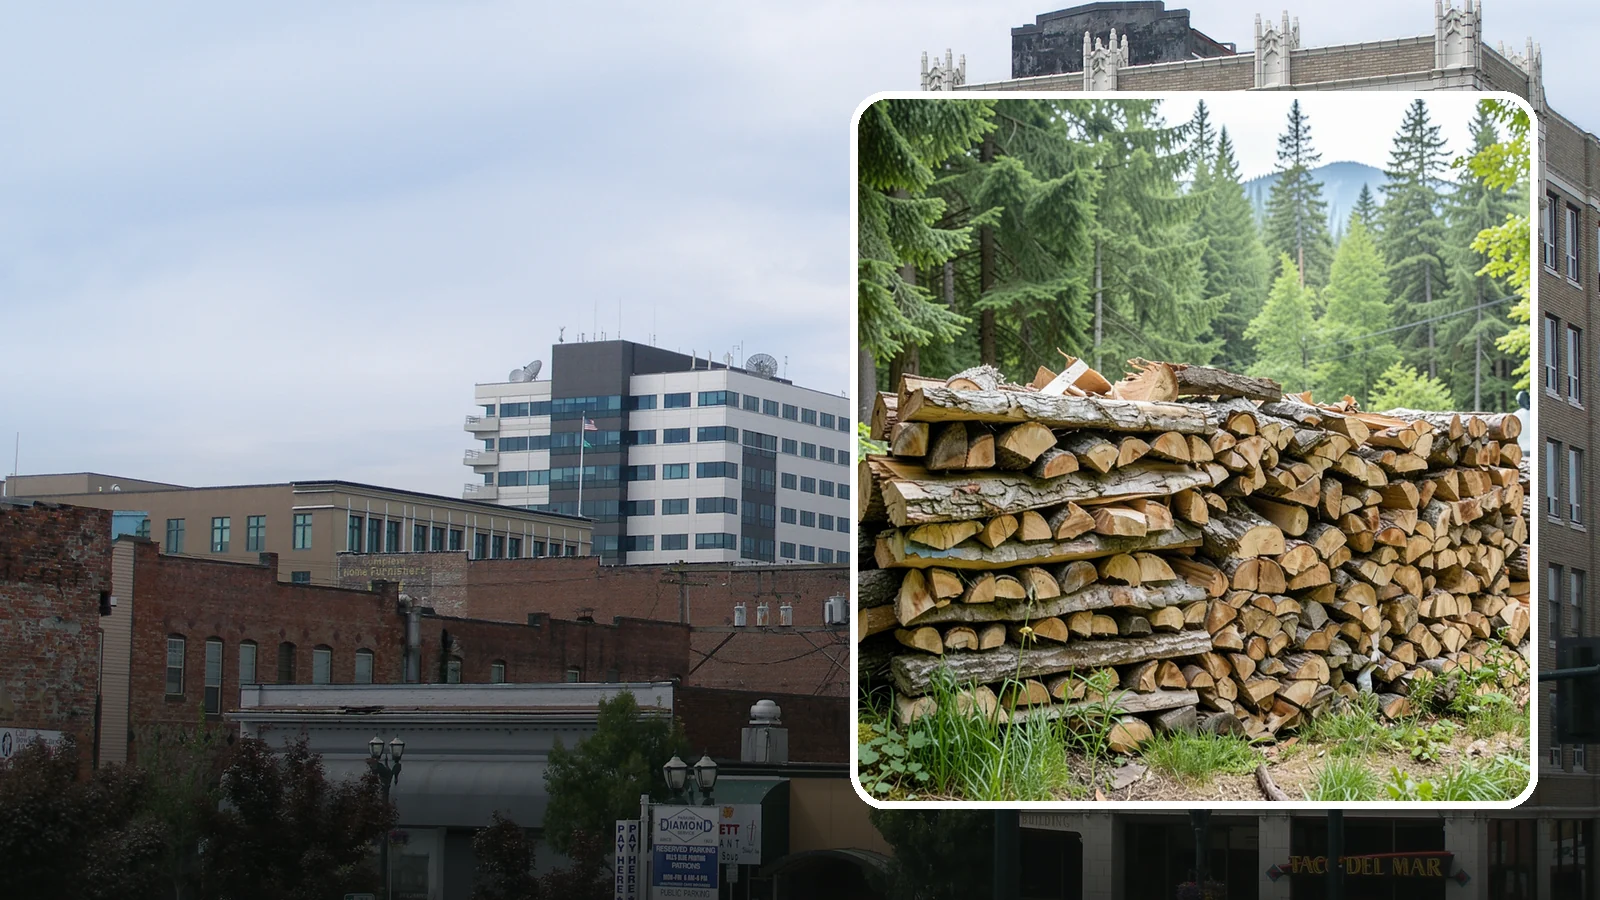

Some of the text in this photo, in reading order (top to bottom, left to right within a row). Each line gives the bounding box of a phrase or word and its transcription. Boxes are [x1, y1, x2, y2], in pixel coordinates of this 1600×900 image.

[343, 566, 426, 577] Home Furnishers
[660, 818, 713, 833] DIAMOND
[1022, 815, 1070, 828] BUILDING
[719, 839, 740, 848] ANT
[689, 846, 716, 854] PARKING
[617, 824, 625, 893] PAY HERE
[628, 824, 636, 893] PAY HERE
[721, 851, 739, 862] Soup
[671, 862, 701, 870] PATRONS
[1289, 855, 1442, 877] TAC DEL MAR
[660, 888, 710, 898] PUBLIC PARKING
